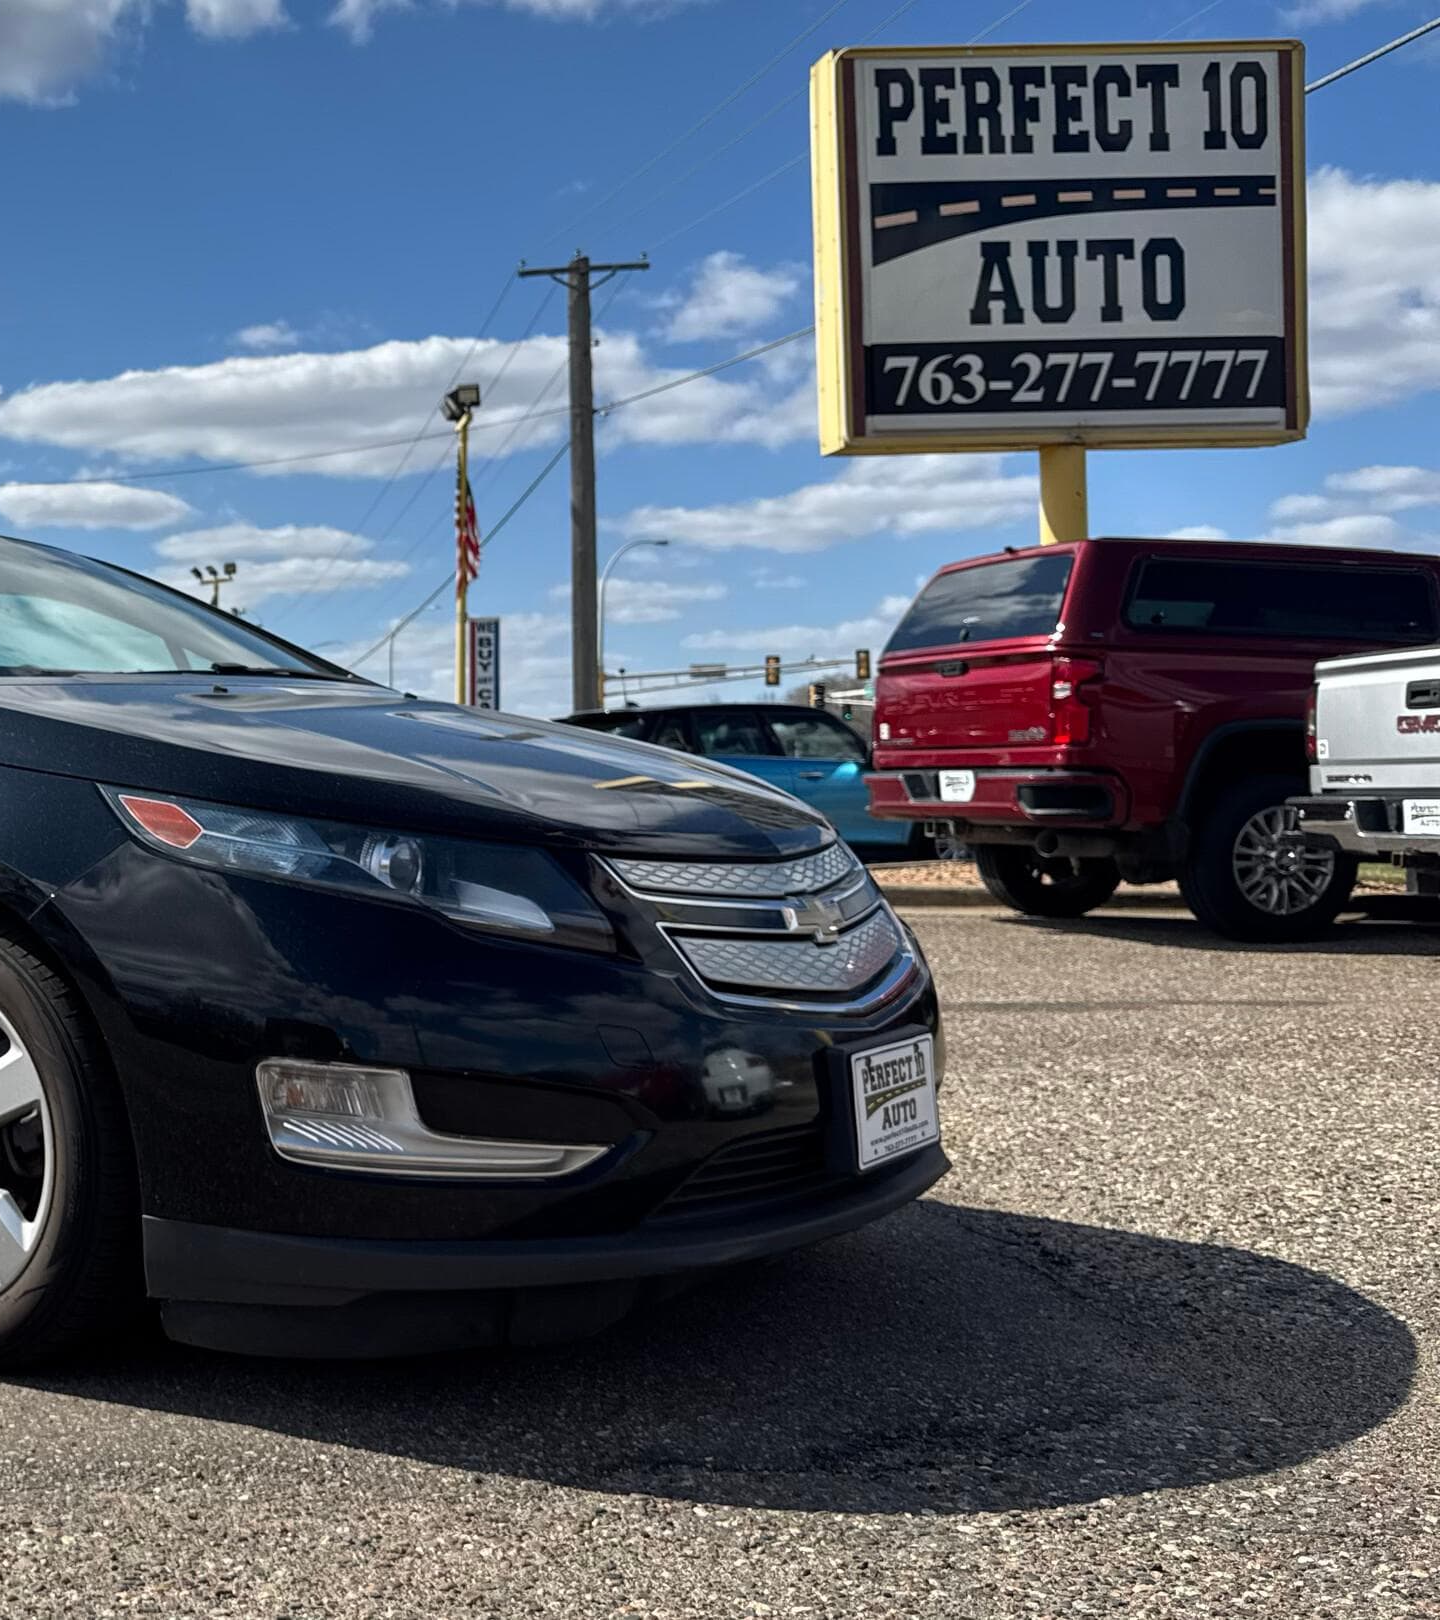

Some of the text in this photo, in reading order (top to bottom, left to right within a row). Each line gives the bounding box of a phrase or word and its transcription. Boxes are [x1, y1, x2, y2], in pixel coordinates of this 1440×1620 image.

[874, 60, 1268, 156] PERFECT 10
[969, 236, 1186, 325] AUTO
[882, 349, 1269, 406] 763-277-7777
[861, 1050, 926, 1095] PERFECT 10
[881, 1097, 917, 1131] AUTO
